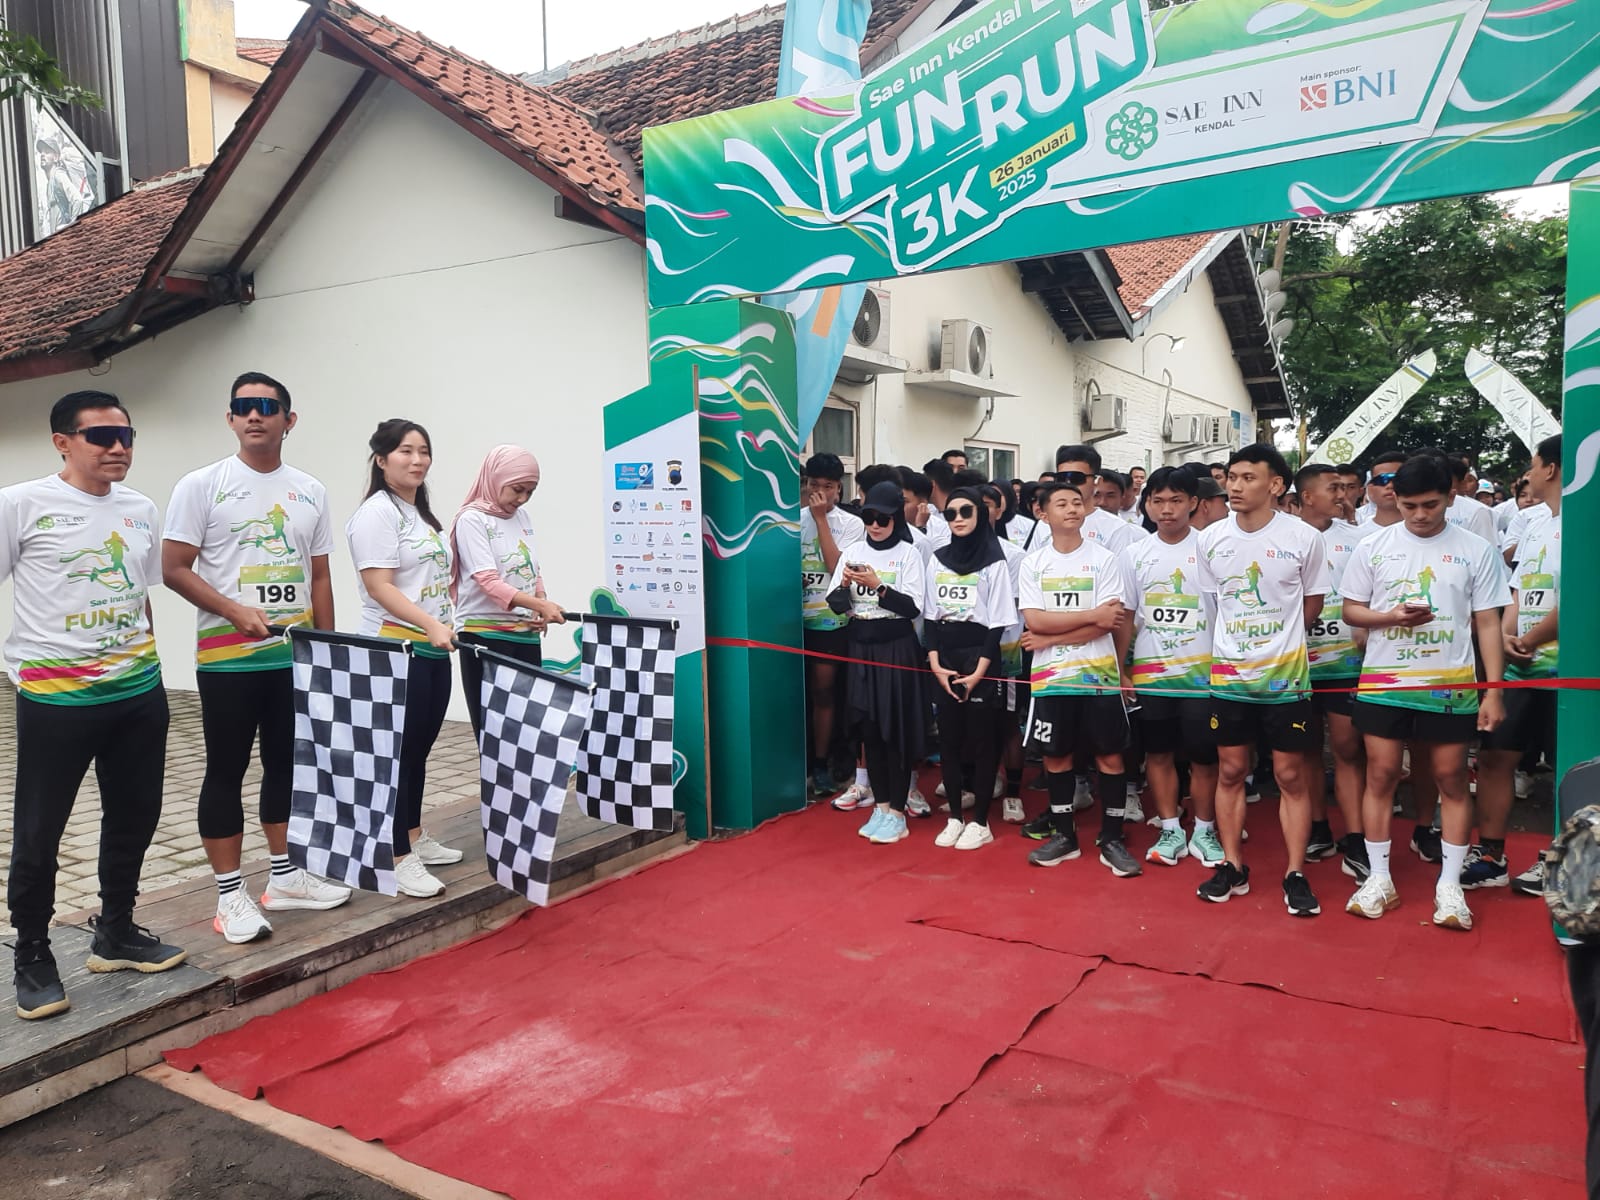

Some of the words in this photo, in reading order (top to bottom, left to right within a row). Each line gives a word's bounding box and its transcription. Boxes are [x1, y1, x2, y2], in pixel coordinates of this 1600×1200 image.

[869, 78, 905, 109] Sae
[909, 54, 943, 84] Inn
[947, 0, 1022, 60] Kendal
[1300, 72, 1322, 83] Main
[1333, 69, 1397, 106] BNI
[832, 70, 966, 200] FUN
[975, 1, 1136, 149] RUN
[1164, 101, 1208, 125] SAE
[1222, 89, 1264, 115] INN
[1194, 119, 1236, 134] KENDAL
[994, 162, 1015, 183] 26
[1016, 129, 1070, 170] Januari
[998, 168, 1038, 202] 2025
[901, 164, 989, 255] 3K
[1346, 412, 1371, 438] SAE
[1373, 385, 1399, 411] INN
[256, 584, 296, 604] 198
[938, 585, 969, 600] 063
[1053, 592, 1080, 607] 171
[90, 599, 107, 607] Sae
[65, 607, 115, 632] FUN
[1153, 608, 1189, 624] 037
[1248, 620, 1285, 638] RUN
[1382, 626, 1413, 641] UN
[1415, 629, 1455, 645] RUN
[96, 633, 122, 652] 3K
[1161, 638, 1179, 651] 3K
[1396, 647, 1419, 661] 3K
[1033, 719, 1053, 743] 22
